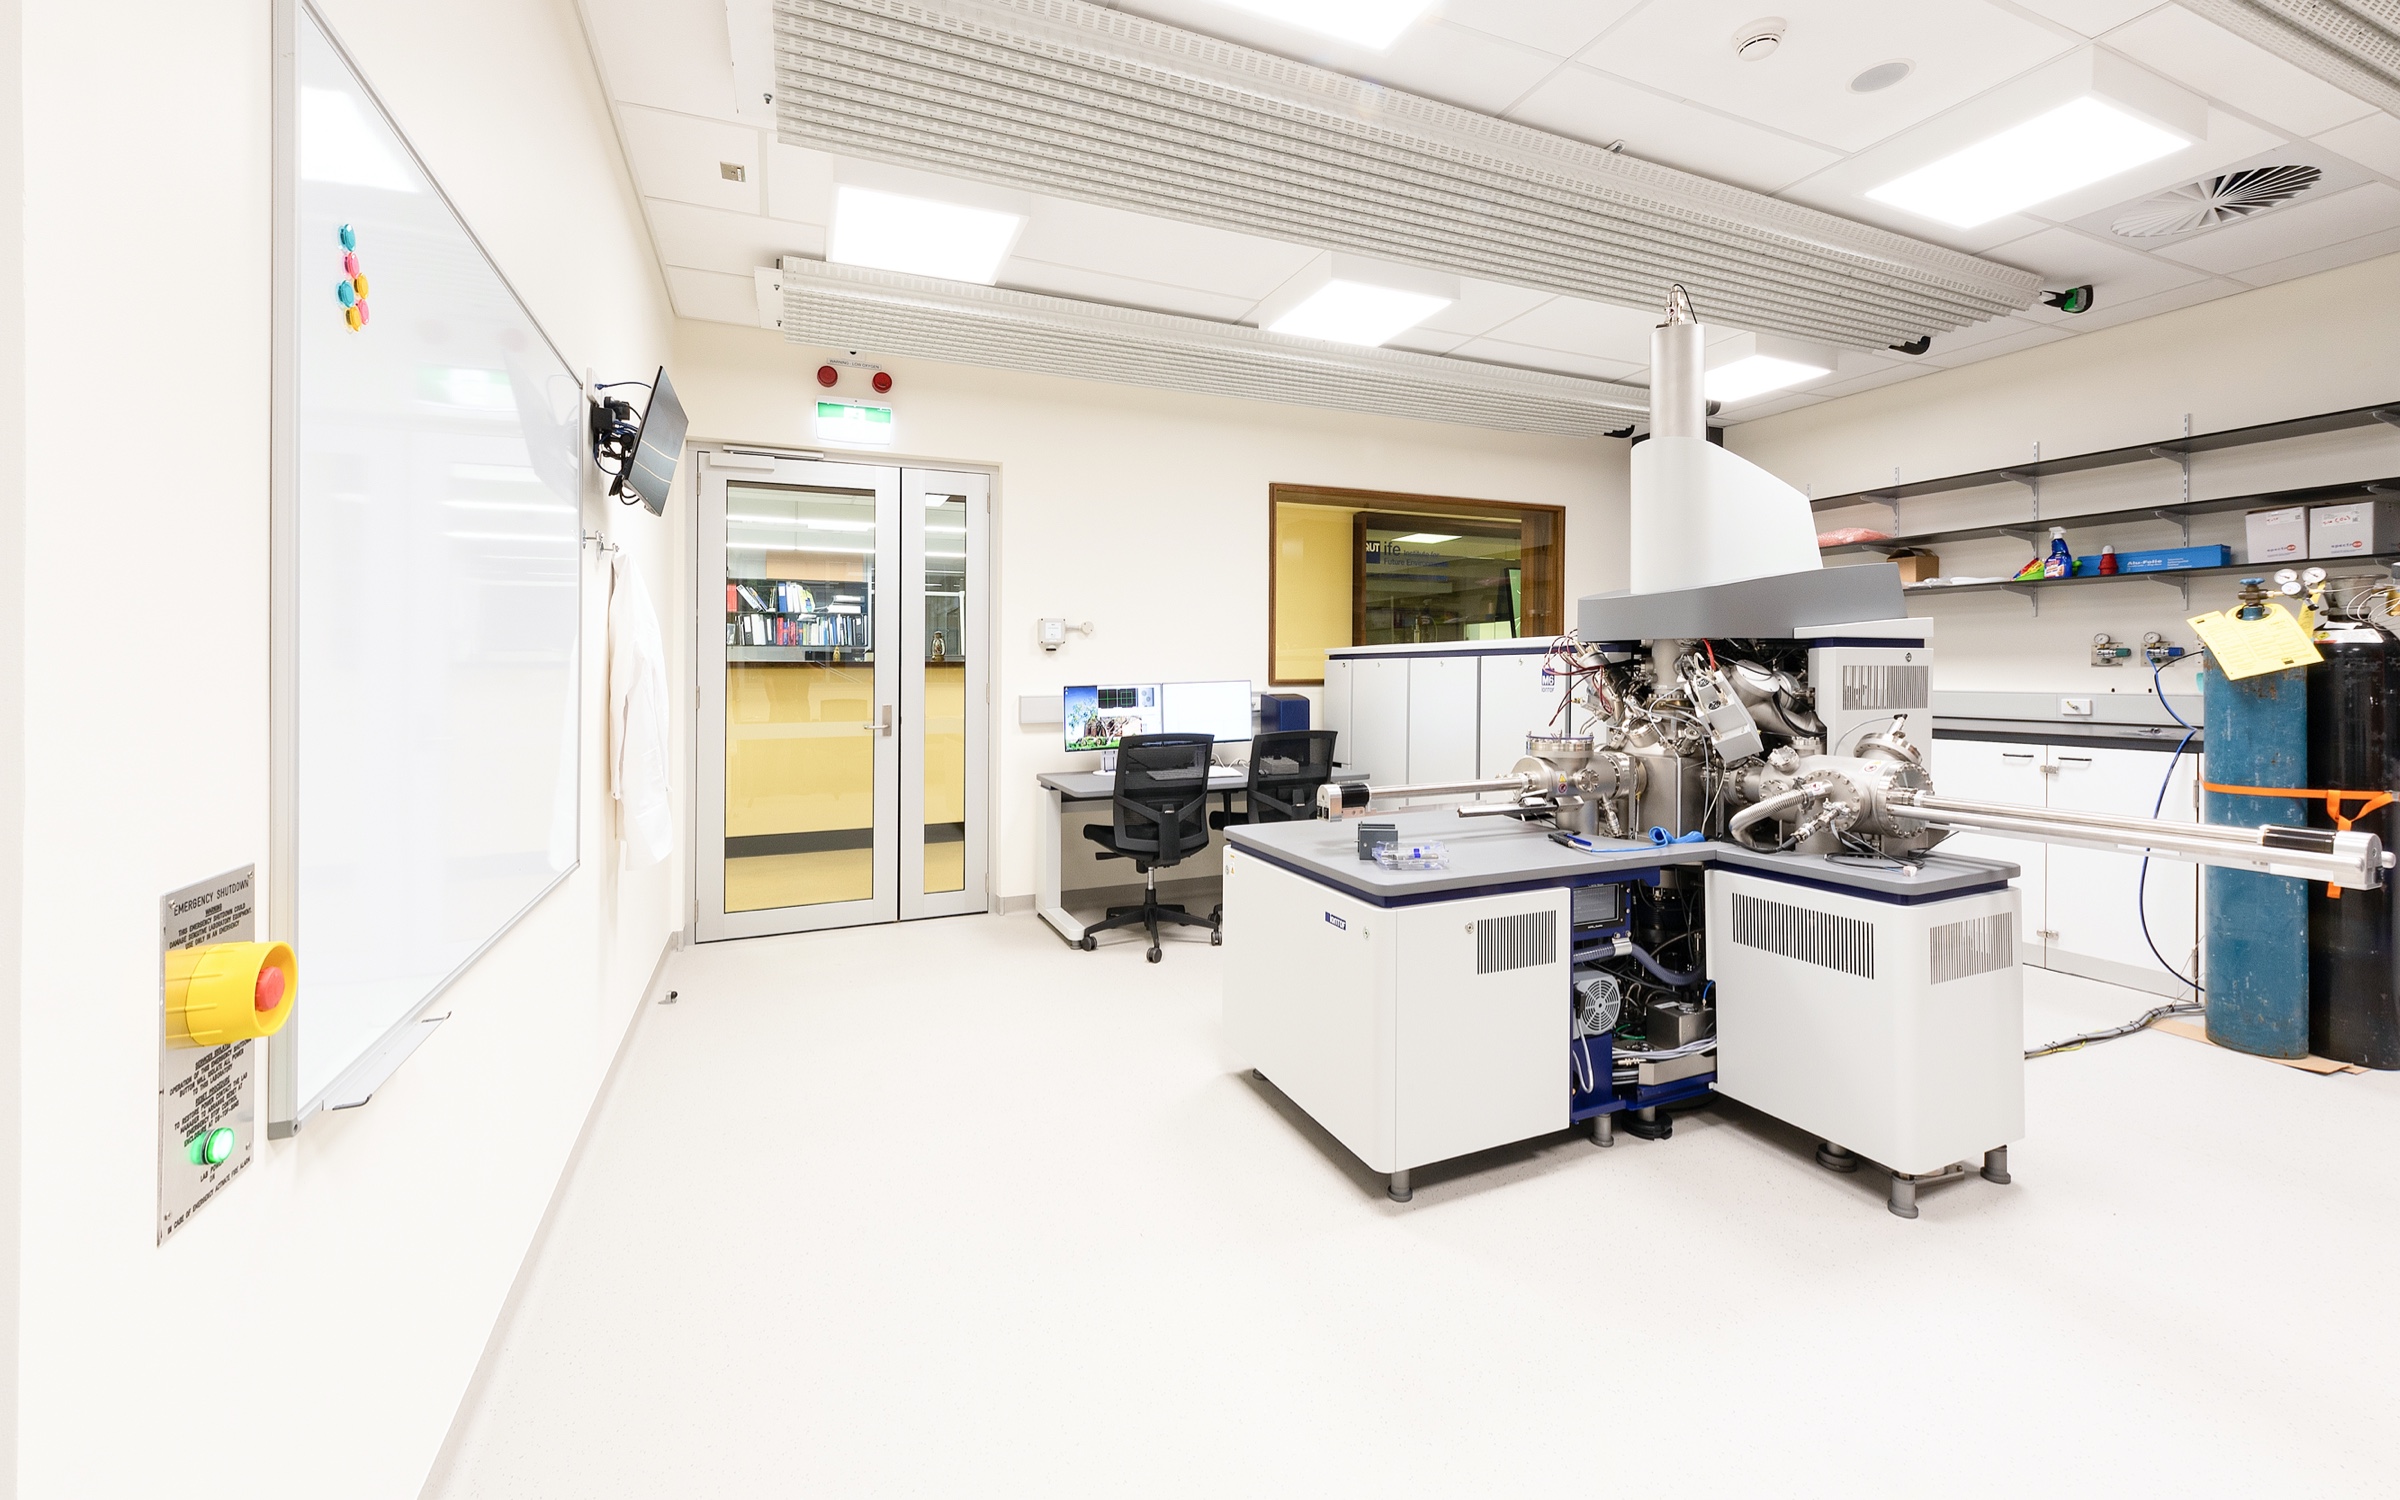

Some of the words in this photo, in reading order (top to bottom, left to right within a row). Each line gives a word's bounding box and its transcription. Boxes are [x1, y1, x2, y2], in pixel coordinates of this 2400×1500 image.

[1384, 541, 1401, 556] ife
[1384, 558, 1405, 566] Future
[1542, 675, 1554, 685] M6
[174, 892, 214, 916] EMERGENCY
[216, 879, 249, 900] SHUTDOWN
